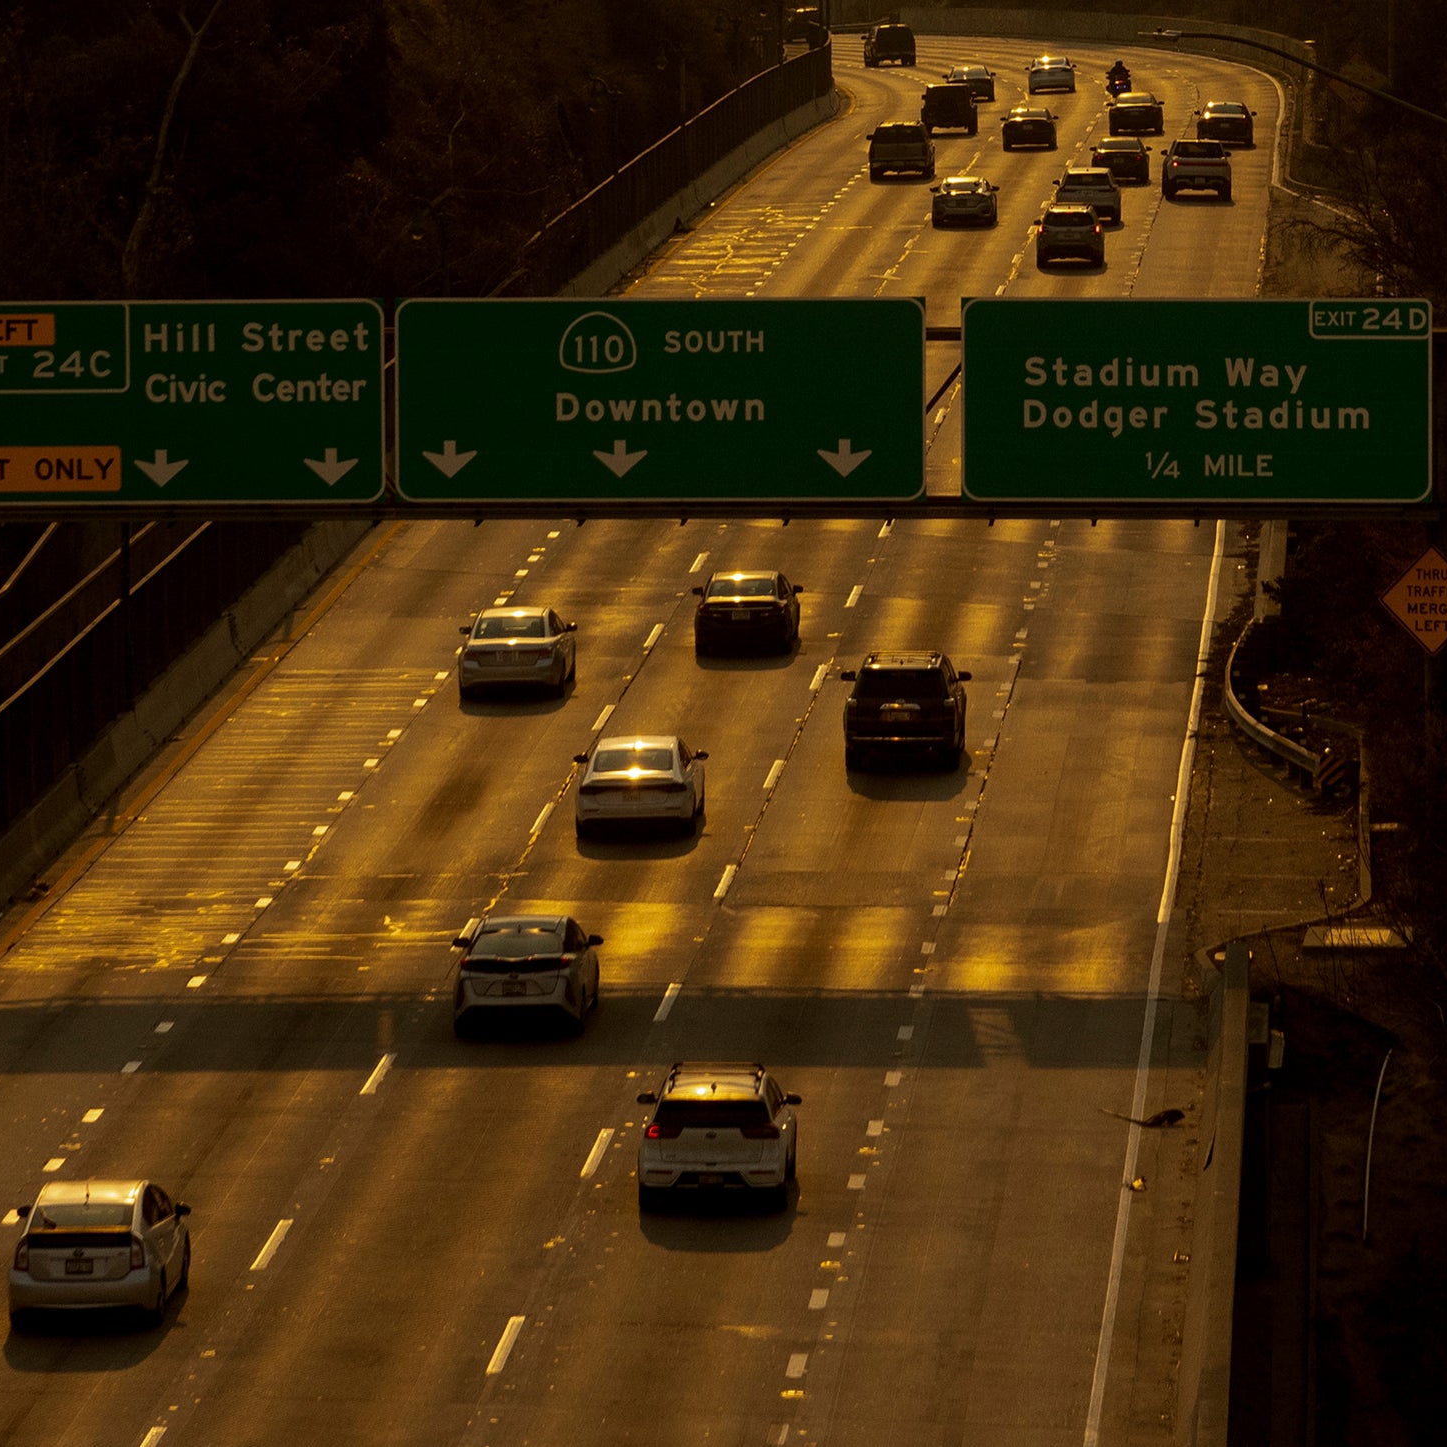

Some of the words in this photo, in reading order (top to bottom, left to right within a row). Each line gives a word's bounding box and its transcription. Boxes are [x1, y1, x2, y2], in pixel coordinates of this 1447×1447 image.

[1314, 310, 1357, 327] EXIT
[1361, 307, 1427, 331] 24D
[144, 323, 215, 353] Hill
[241, 322, 369, 352] Street
[574, 335, 624, 363] 110
[664, 330, 764, 354] SOUTH
[33, 349, 111, 378] 24C
[1024, 356, 1199, 387] Stadium
[1224, 357, 1307, 394] Way
[145, 373, 227, 403] Civic
[252, 372, 367, 402] Center
[556, 392, 765, 422] Downtown
[1023, 399, 1169, 438] Dodger
[1195, 399, 1370, 430] Stadium
[34, 457, 114, 481] ONLY
[1204, 454, 1274, 477] MILE
